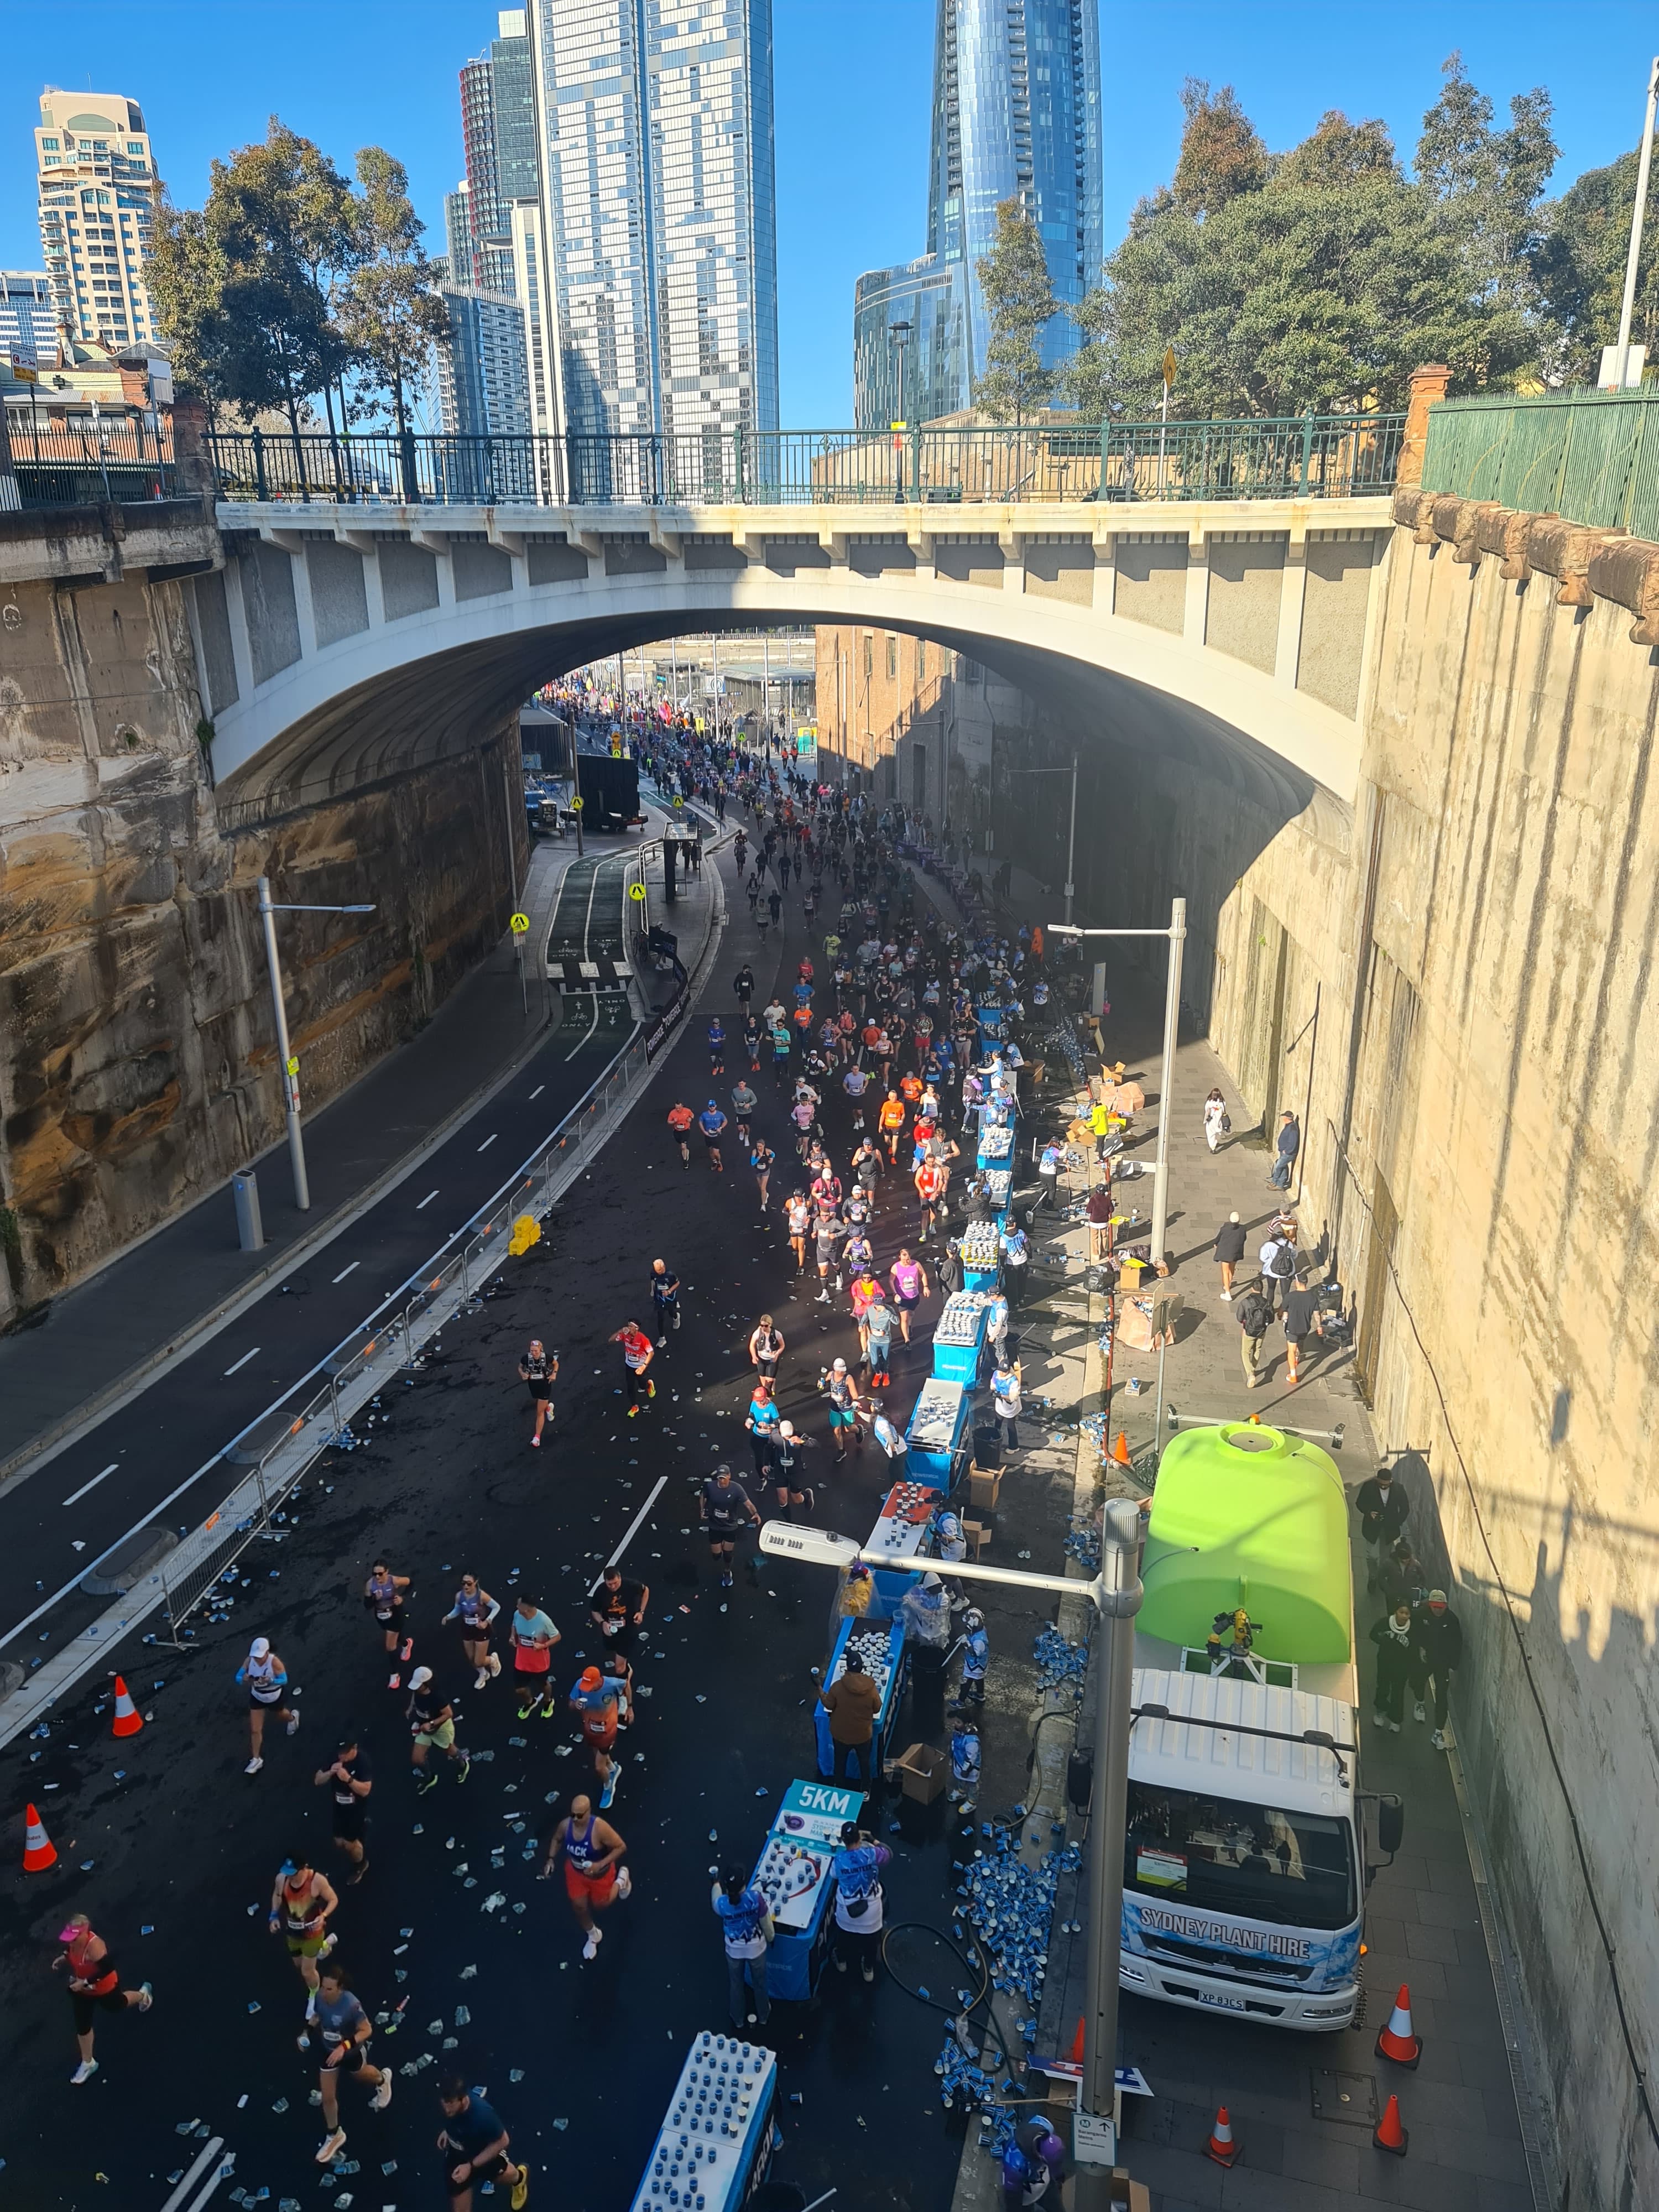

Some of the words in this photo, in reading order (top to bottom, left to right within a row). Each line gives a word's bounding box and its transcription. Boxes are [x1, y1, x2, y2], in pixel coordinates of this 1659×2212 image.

[647, 1024, 664, 1055] POWERADE
[799, 1786, 851, 1815] 5KM
[1140, 1907, 1208, 1938] SYDNEY
[1210, 1923, 1266, 1950] PLANT
[1269, 1934, 1310, 1959] HIRE
